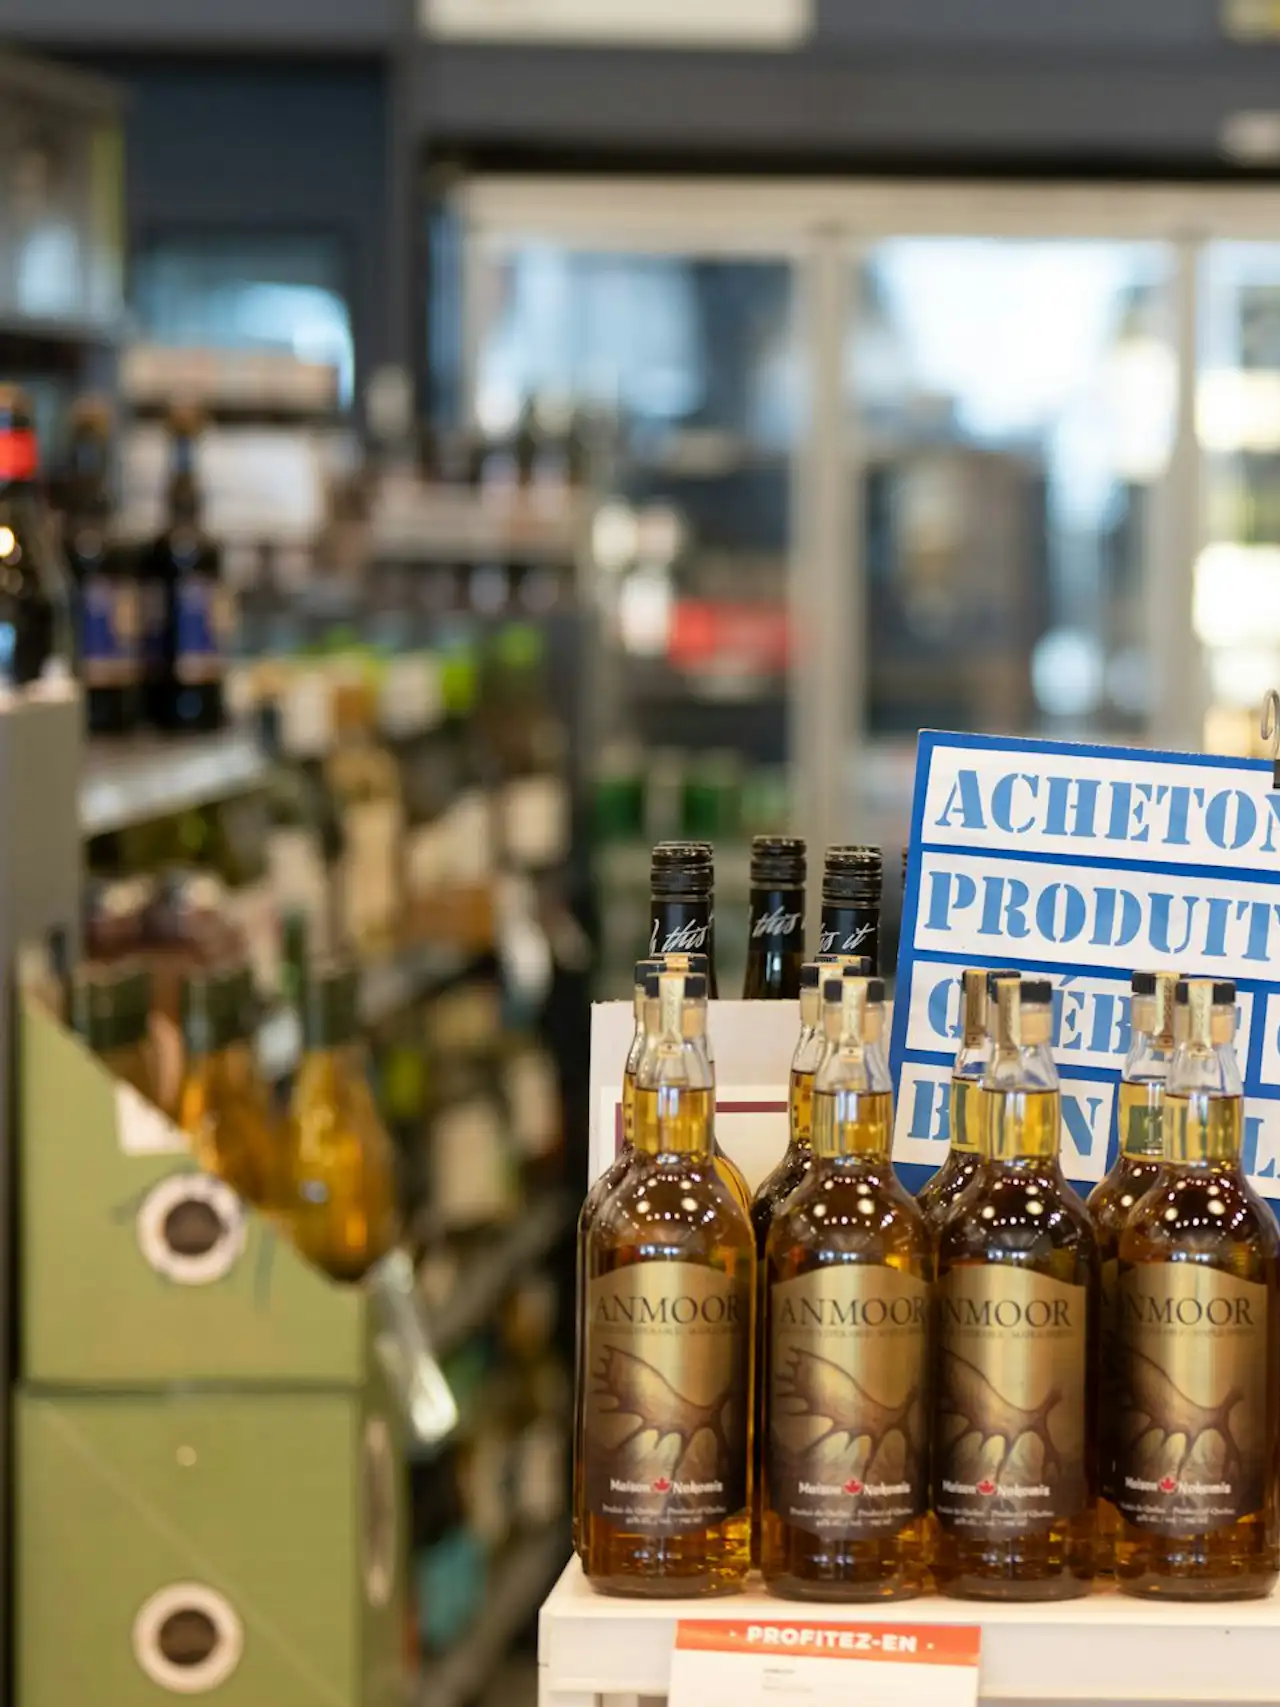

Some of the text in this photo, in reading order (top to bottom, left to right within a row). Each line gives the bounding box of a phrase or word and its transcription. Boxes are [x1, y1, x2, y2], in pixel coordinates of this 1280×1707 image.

[928, 974, 1241, 1054] QÉB
[944, 1298, 1072, 1328] NMOOR
[1126, 1293, 1254, 1326] NMOOR
[747, 1626, 917, 1653] PROFITEZ-EN
